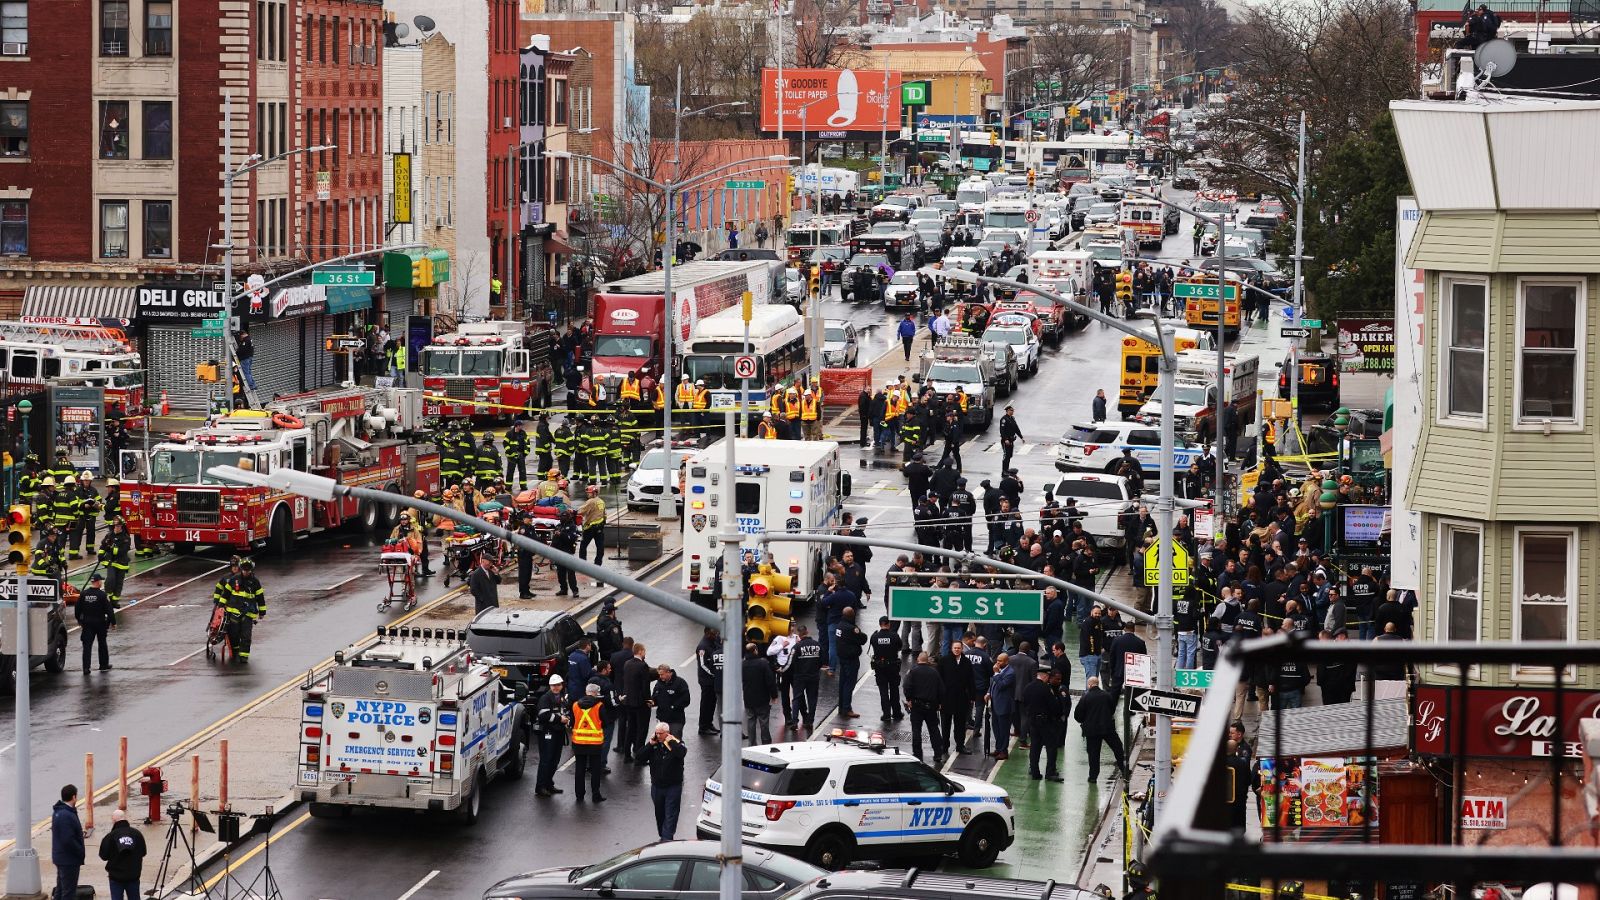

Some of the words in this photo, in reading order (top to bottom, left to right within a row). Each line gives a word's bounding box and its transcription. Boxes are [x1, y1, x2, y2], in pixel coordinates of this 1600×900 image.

[791, 79, 828, 89] GOODBYE
[785, 91, 806, 99] TOILET
[807, 91, 828, 99] PAPER
[905, 87, 923, 101] TD
[800, 174, 834, 182] POLCE
[328, 274, 342, 283] 36
[346, 274, 361, 283] St
[1190, 287, 1203, 295] 36
[1207, 287, 1220, 295] St
[139, 289, 177, 307] DELI
[25, 316, 69, 326] FLOWERS
[1352, 333, 1394, 342] BAKER
[1363, 344, 1381, 352] OPEN
[428, 406, 441, 414] 201
[1174, 454, 1190, 464] YPD
[736, 517, 760, 526] YPD
[185, 530, 201, 542] 114
[1350, 563, 1359, 571] 36
[1147, 572, 1186, 581] SCOL
[0, 584, 18, 594] ONE
[31, 585, 51, 596] WAY
[929, 595, 963, 615] 35
[974, 596, 1004, 616] St
[1237, 618, 1255, 627] POLICE
[1181, 671, 1199, 687] 35
[356, 700, 407, 714] NYPD
[1141, 695, 1161, 707] ONE
[1170, 699, 1192, 711] WAY
[347, 712, 415, 727] POLICE
[1494, 696, 1557, 737] La
[344, 745, 386, 756] EMERGENCY
[387, 748, 416, 758] SERVICE
[741, 791, 764, 801] OLICE
[1462, 800, 1505, 818] ATM
[908, 807, 954, 828] NYPD
